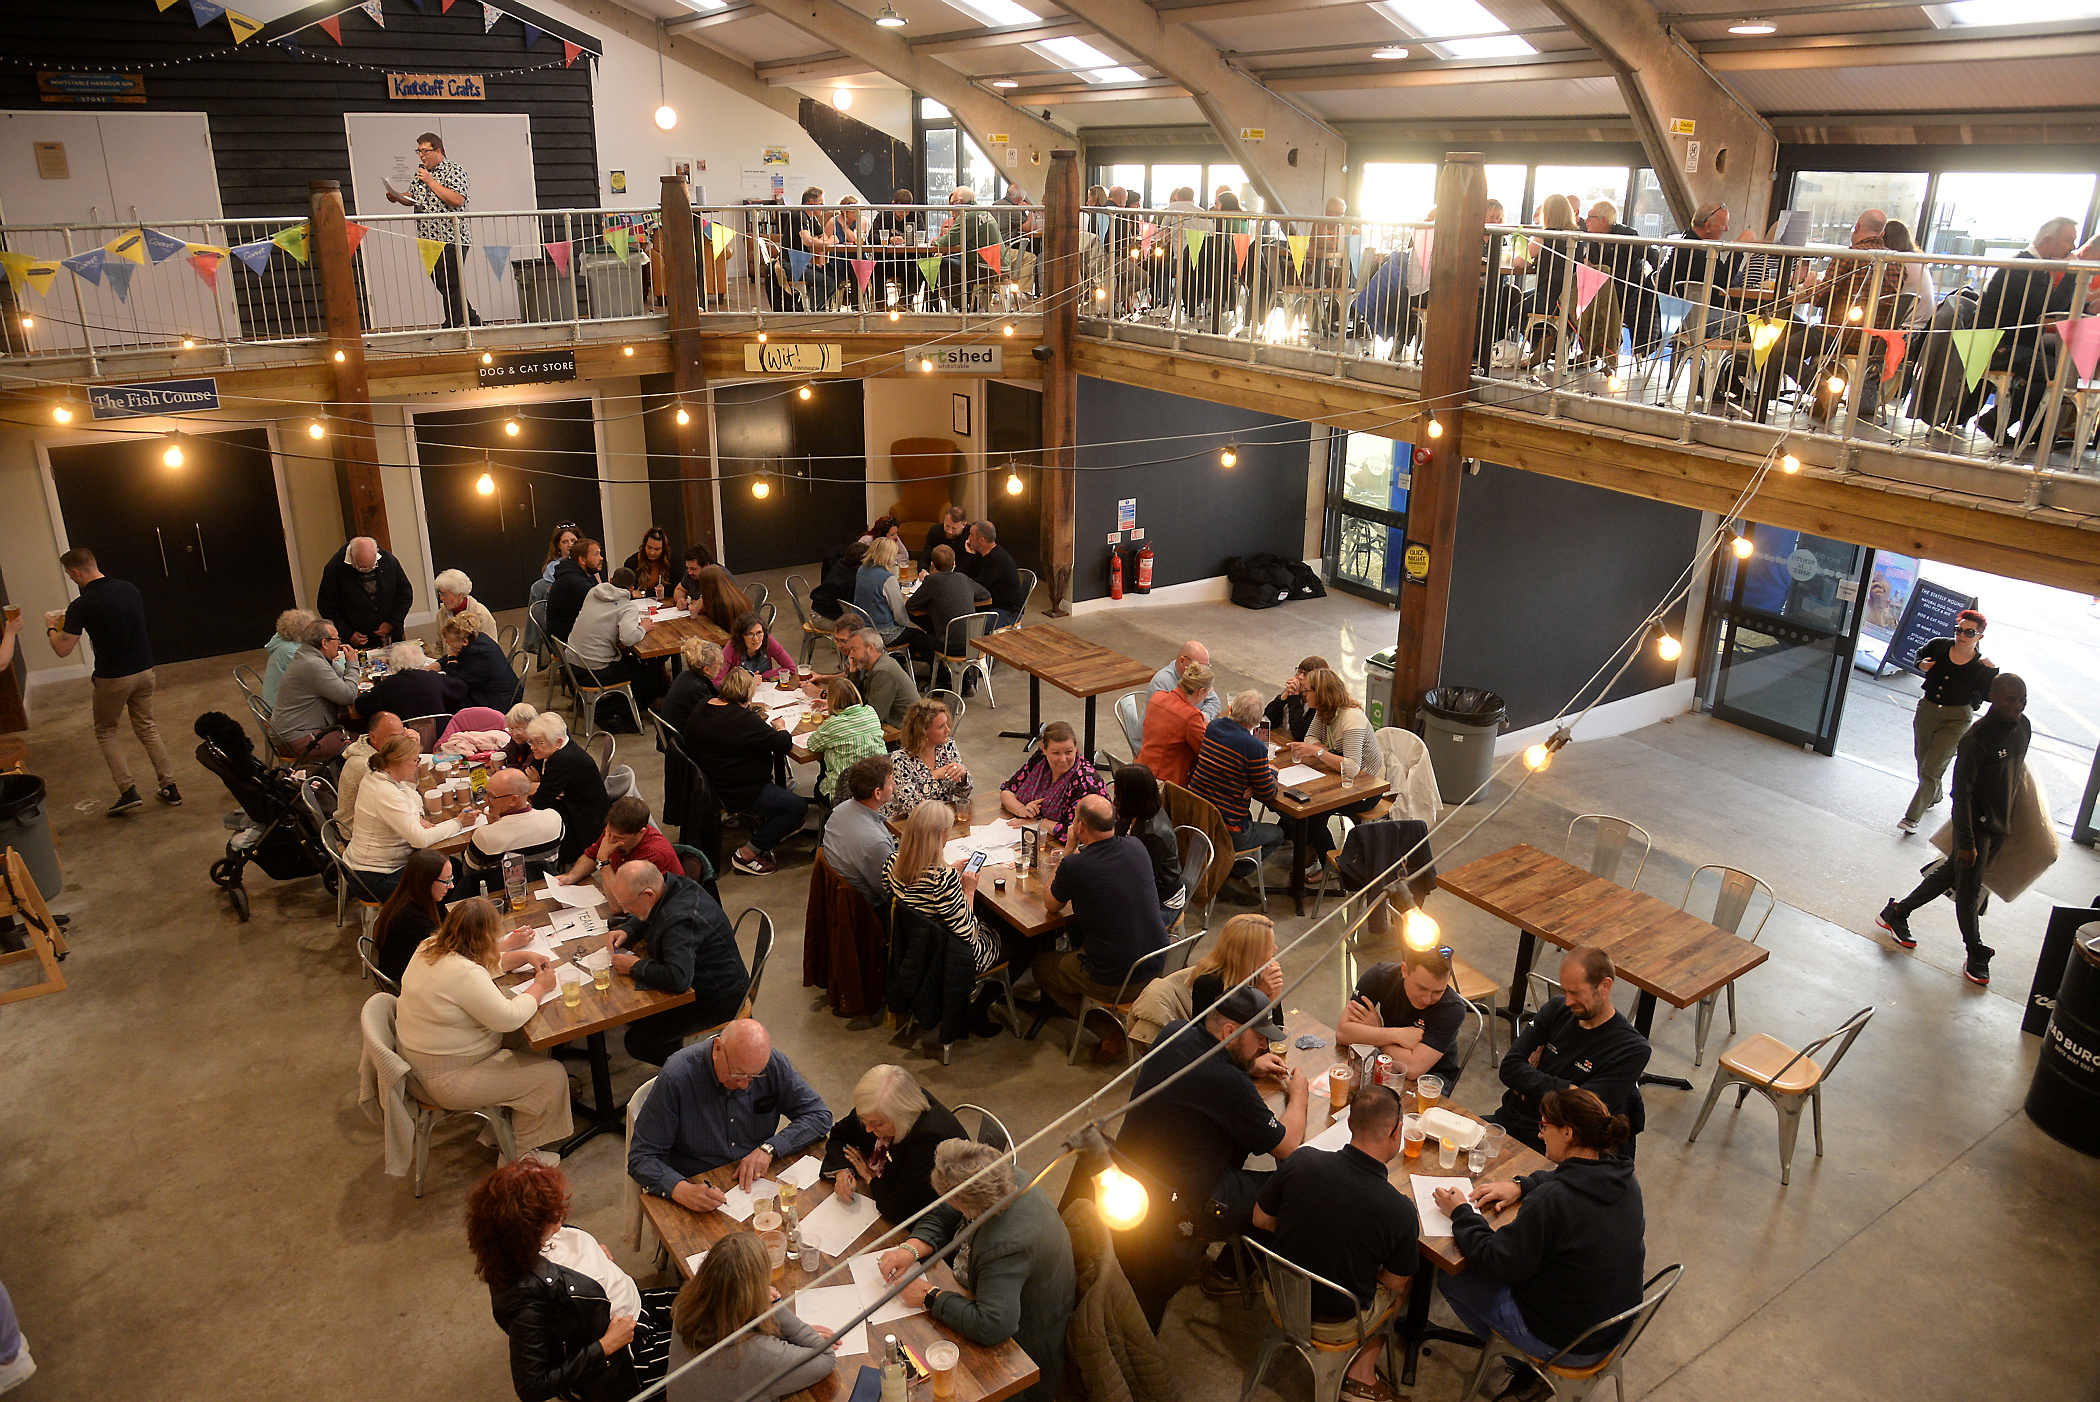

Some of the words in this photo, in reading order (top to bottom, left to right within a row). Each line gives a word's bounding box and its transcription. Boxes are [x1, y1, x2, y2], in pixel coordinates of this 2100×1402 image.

[448, 78, 481, 97] Crafts
[480, 367, 505, 377] DOG
[509, 366, 516, 374] &
[519, 364, 539, 374] CAT
[543, 361, 574, 371] STORE
[94, 393, 125, 409] The
[126, 390, 160, 407] Fish
[162, 390, 212, 404] Course
[1921, 597, 1937, 607] NATURAL
[1930, 591, 1947, 602] STATELY
[1948, 597, 1965, 608] HOUND
[1938, 619, 1949, 627] FOOD
